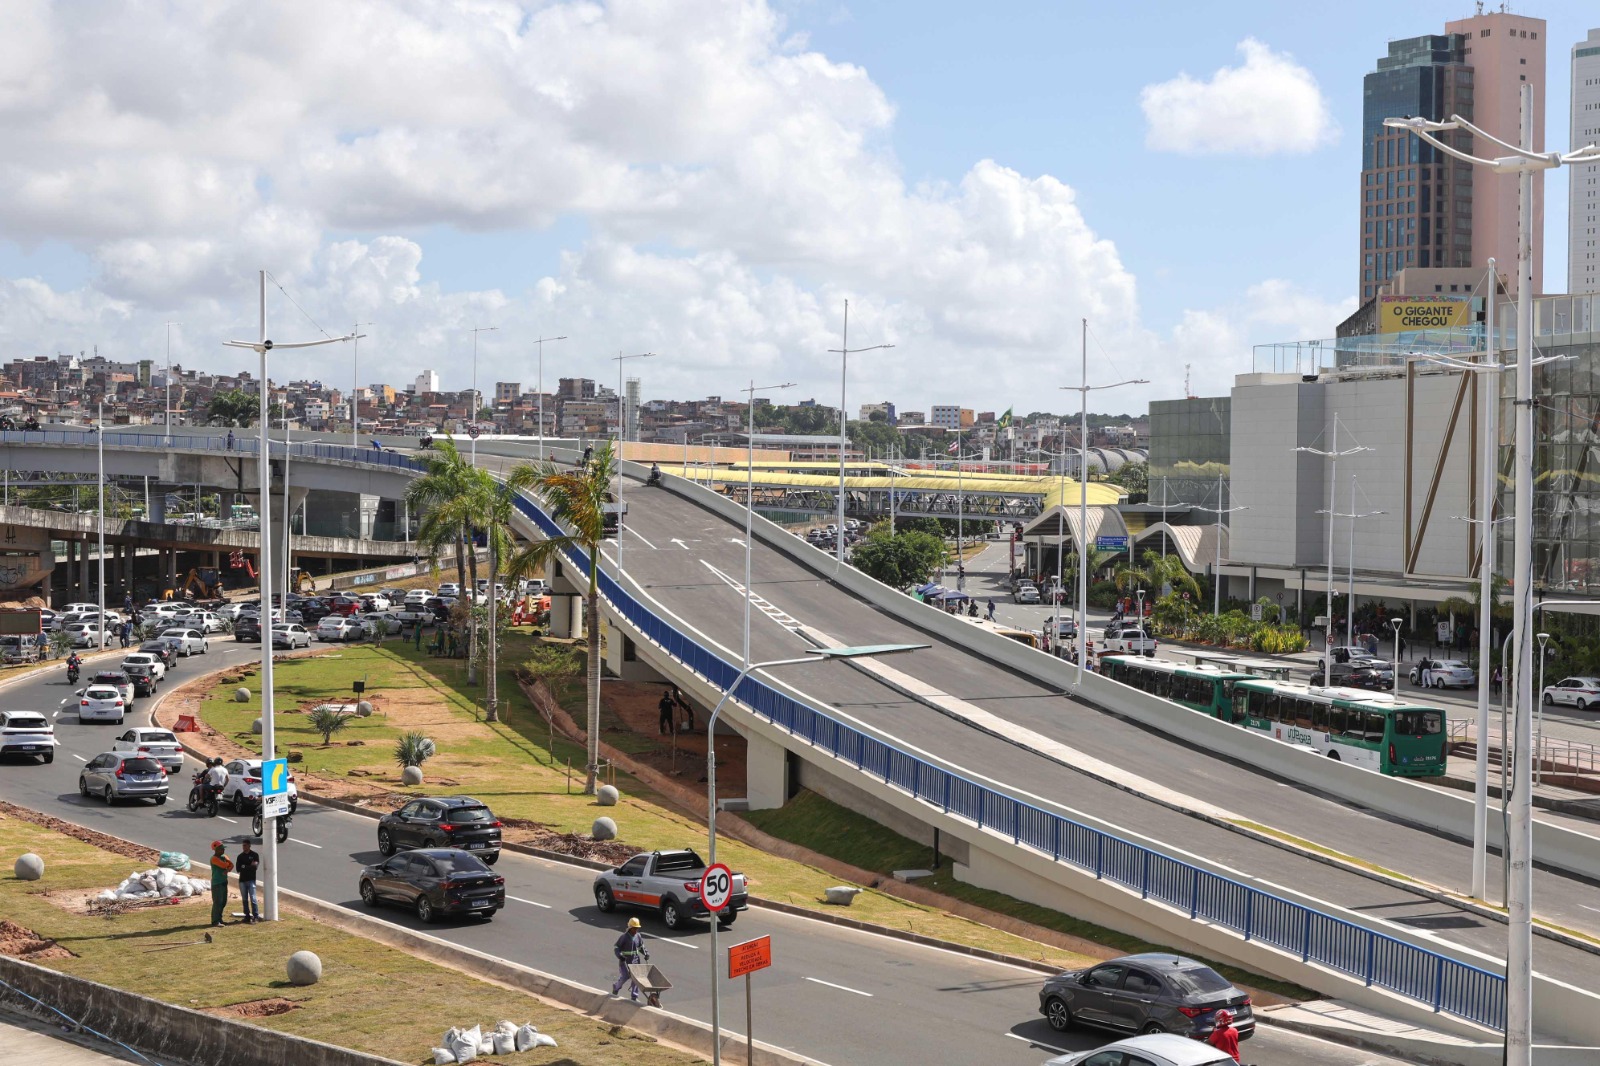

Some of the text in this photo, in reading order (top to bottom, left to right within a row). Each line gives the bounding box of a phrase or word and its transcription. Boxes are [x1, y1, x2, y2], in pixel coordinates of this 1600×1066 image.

[1393, 306, 1453, 316] O GIGANTE
[1402, 316, 1447, 326] CHEGOU
[706, 873, 729, 896] 50
